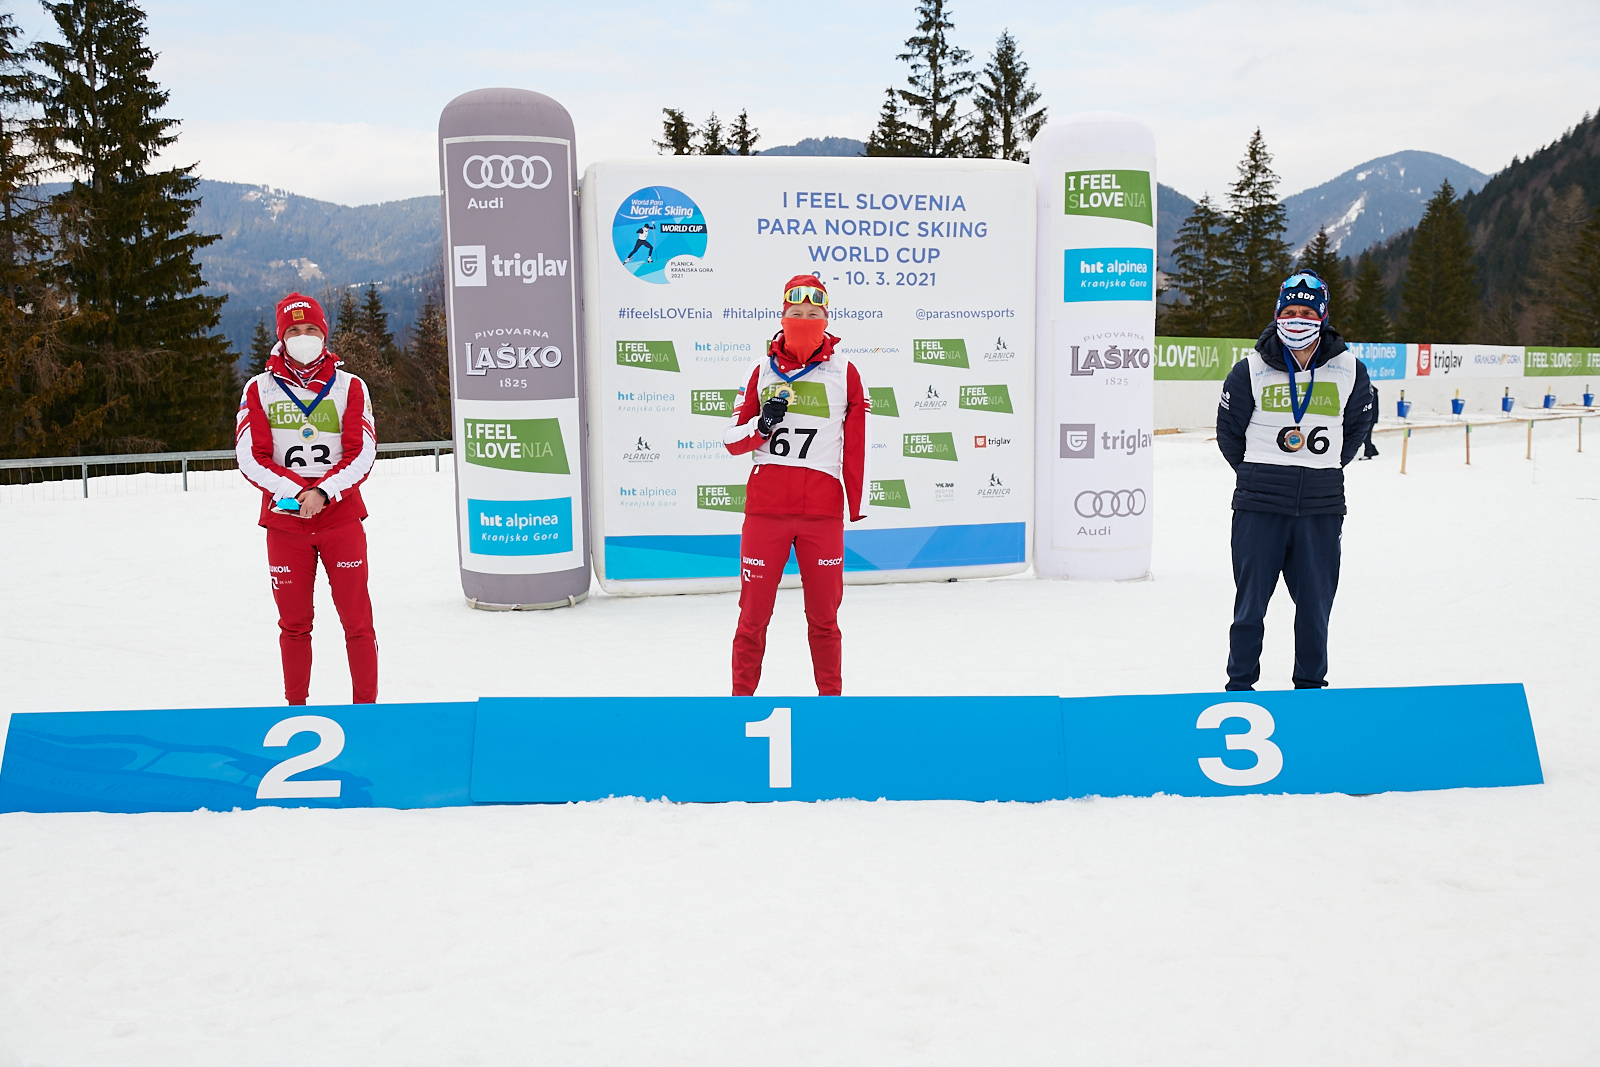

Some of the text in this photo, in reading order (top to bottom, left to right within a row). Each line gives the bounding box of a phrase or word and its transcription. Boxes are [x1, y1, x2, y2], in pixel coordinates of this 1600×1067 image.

[1068, 173, 1121, 191] I FEEL
[467, 197, 504, 209] Audi
[783, 191, 967, 212] I FEEL SLOVENIA
[1069, 192, 1146, 209] SLOVENIA
[630, 205, 694, 219] Nordic Skiing
[757, 218, 988, 238] PARA NORDIC SKIING
[808, 245, 941, 264] WORLD CUP
[491, 252, 568, 284] triglav
[1080, 259, 1148, 276] hit alpinea
[845, 271, 870, 285] 10.
[876, 271, 890, 285] 3.
[896, 272, 936, 286] 2021
[1080, 279, 1147, 289] Kranjska Gora
[284, 301, 312, 313] LUKOIL
[618, 307, 1015, 322] #ifeelsLOVEnia #hitalpine njskagora @parasnowsports
[475, 328, 549, 340] PIVOVARNA
[1083, 331, 1145, 342] PIVOVARNA
[618, 342, 649, 352] I FEEL
[694, 341, 751, 353] hit alpinea
[915, 340, 943, 350] I FEEL
[464, 342, 563, 376] LAŠKO
[619, 353, 670, 363] SLOVENIA
[915, 350, 961, 360] SLOVENIA
[983, 352, 1015, 360] PLANICA
[1365, 343, 1397, 363] alpinea
[1474, 354, 1522, 364] KRANJSKA GORA
[695, 356, 729, 364] Kranjska
[1069, 345, 1150, 377] LAŠKO
[1434, 351, 1463, 374] triglav
[1527, 352, 1532, 368] I
[1532, 352, 1549, 368] FEEL
[1549, 352, 1583, 368] SLOVENIA
[1587, 353, 1592, 368] I
[1379, 366, 1395, 377] Gora
[499, 377, 528, 389] 1825
[1105, 377, 1129, 386] 1825
[693, 391, 724, 401] I FEEL
[961, 387, 987, 397] I FEEL
[1264, 384, 1307, 397] I FEL
[617, 391, 675, 403] hit alpinea
[961, 396, 1004, 406] SLOVENIA
[276, 402, 301, 413] FEE
[617, 405, 653, 413] Kranjska
[693, 401, 733, 411] SLOVEN
[914, 400, 947, 408] PLANICA
[270, 413, 331, 425] SLOVENIA
[466, 422, 517, 440] I FEEL
[677, 439, 725, 451] hit alpine
[769, 427, 818, 459] 67
[904, 435, 932, 444] I FEEL
[988, 436, 1011, 448] triglav
[1101, 428, 1152, 456] triglav
[467, 441, 554, 459] SLOVENIA
[904, 444, 949, 454] SLOVENIA
[284, 444, 332, 468] 63
[622, 453, 660, 461] PLANICA
[677, 453, 712, 461] Kranjska
[620, 486, 677, 498] hit alpinea
[699, 487, 729, 496] I FEEL
[977, 488, 1011, 496] PLANICA
[620, 499, 677, 508] Kranjska Gora
[699, 496, 747, 506] SLOVENIA
[480, 511, 559, 530] hit alpinea
[1076, 526, 1111, 536] Audi
[481, 531, 559, 545] Kranjska Gora
[745, 707, 792, 789] 1
[1196, 701, 1284, 787] 3
[256, 715, 346, 800] 2
